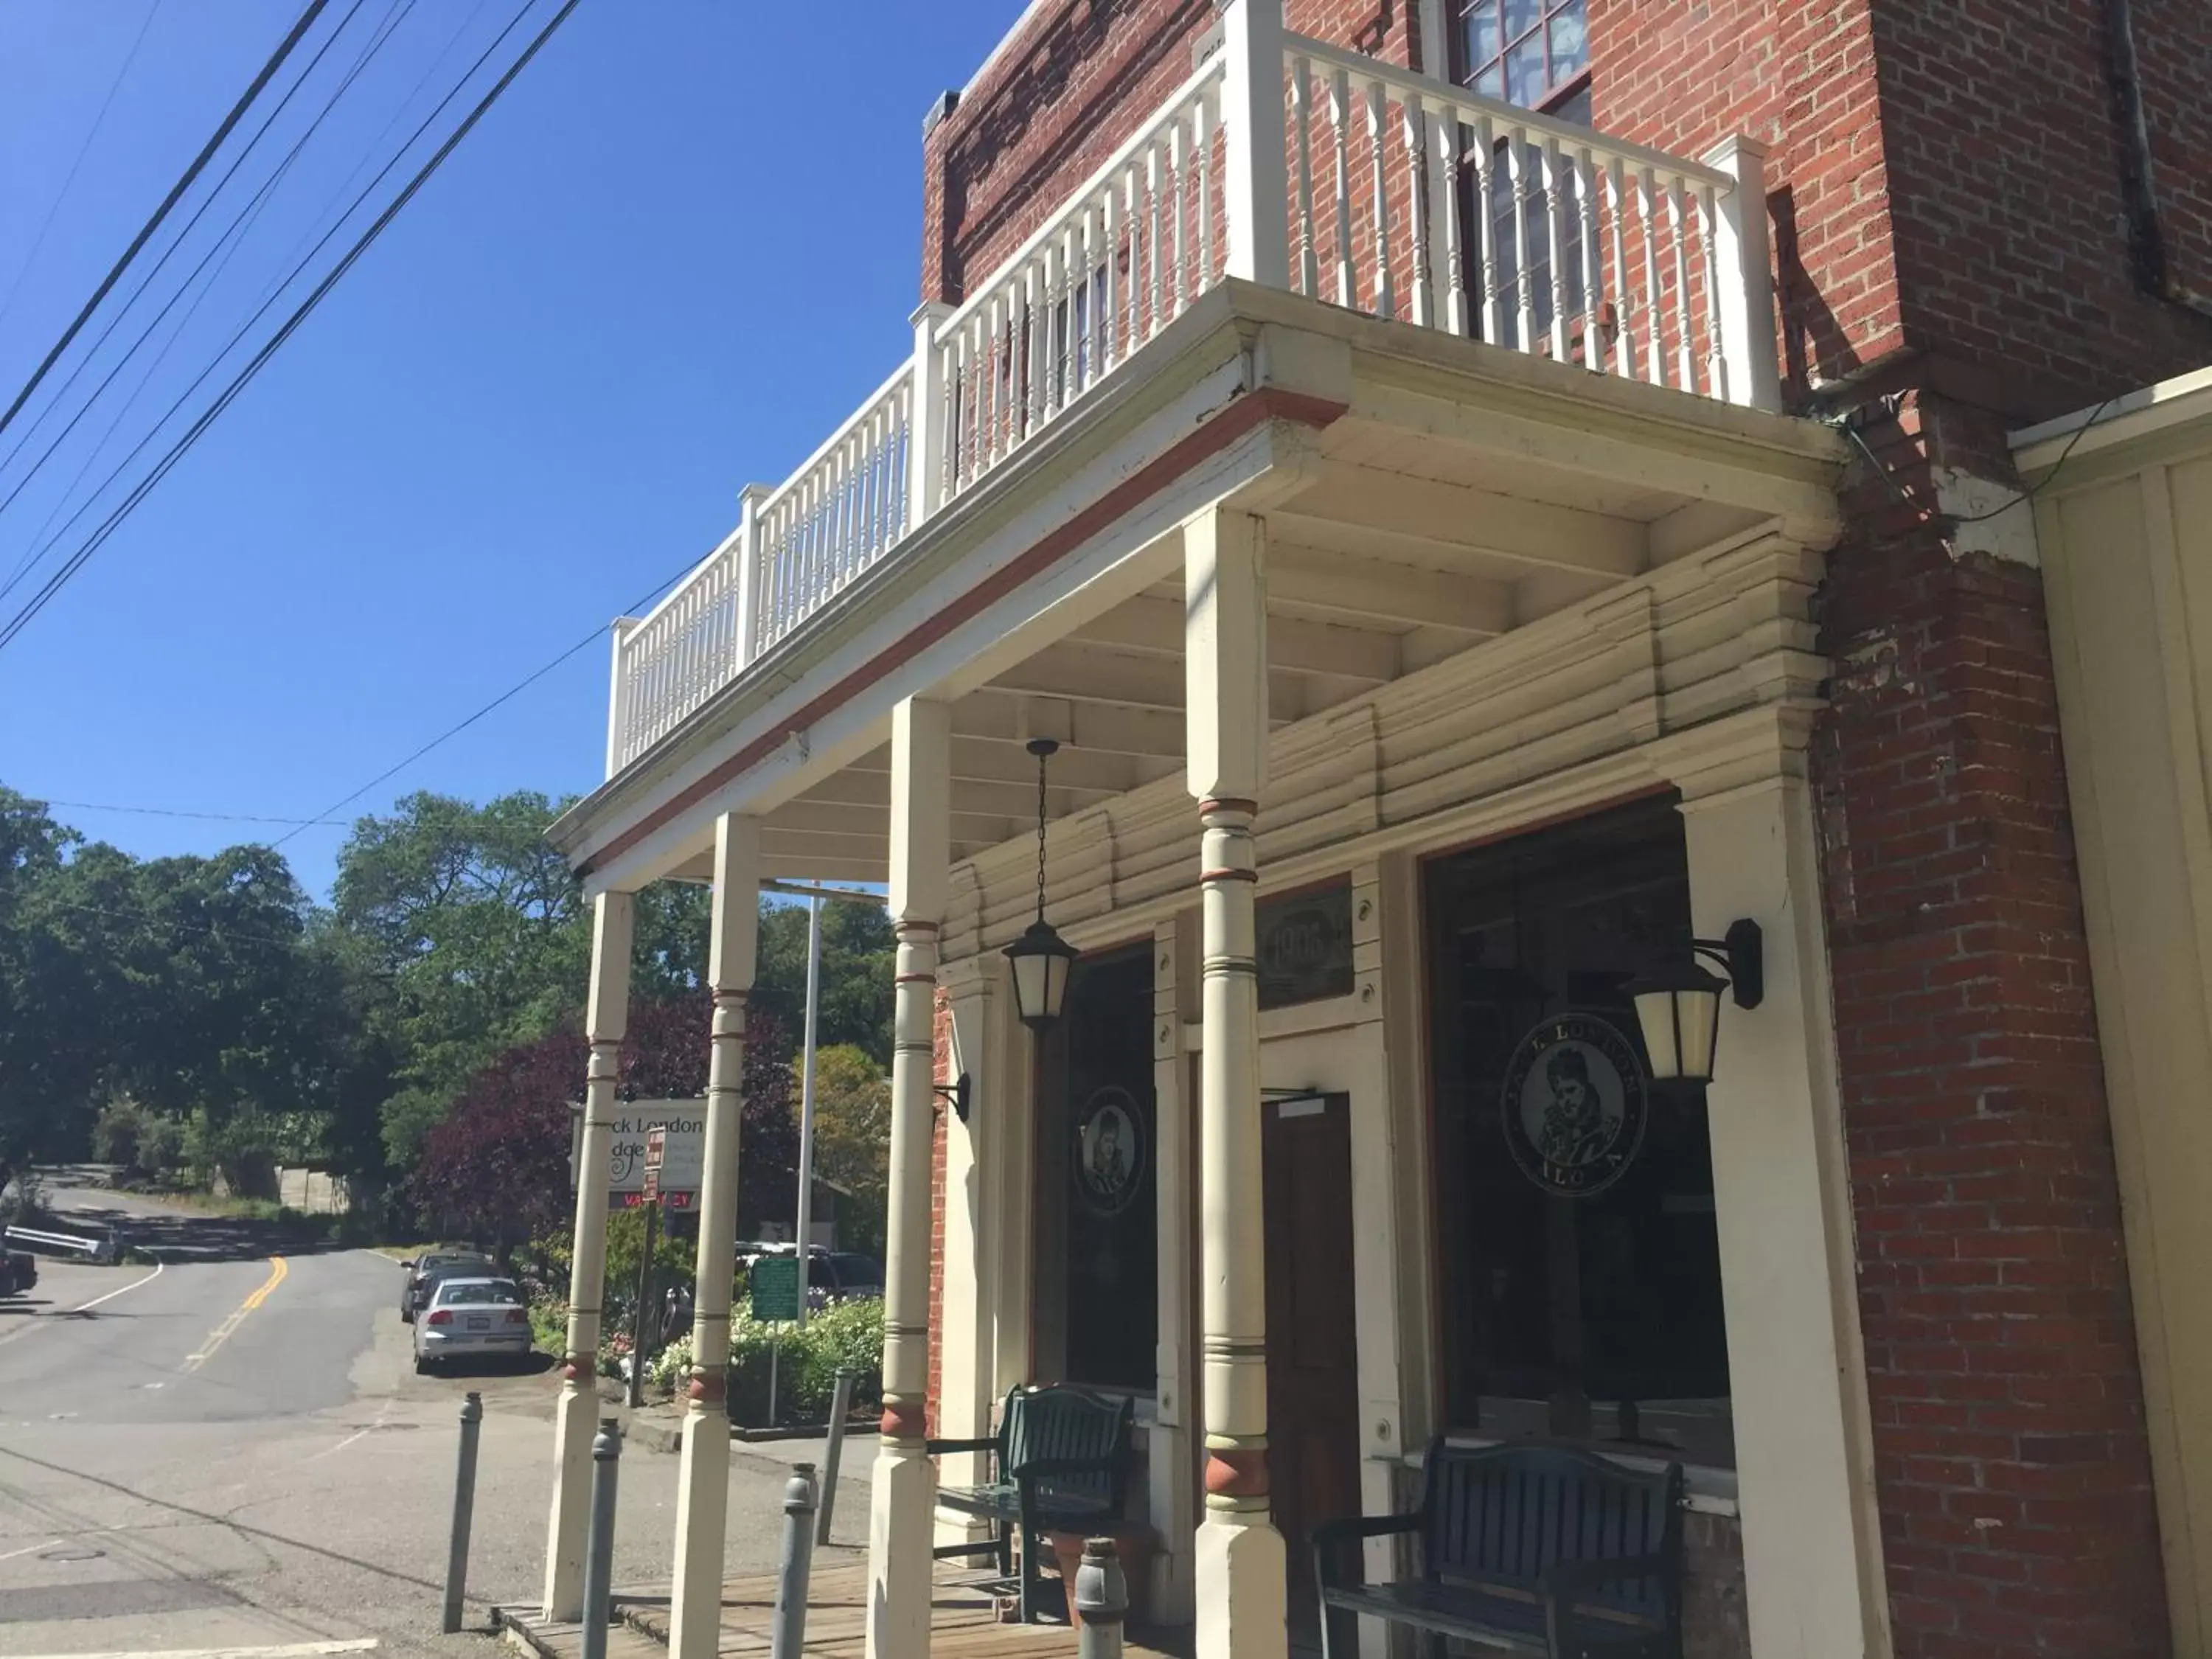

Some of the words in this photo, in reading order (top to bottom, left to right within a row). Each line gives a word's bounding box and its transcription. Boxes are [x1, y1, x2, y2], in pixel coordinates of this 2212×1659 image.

[612, 1117, 631, 1133] ck
[636, 1116, 703, 1133] London
[611, 1141, 644, 1183] dge
